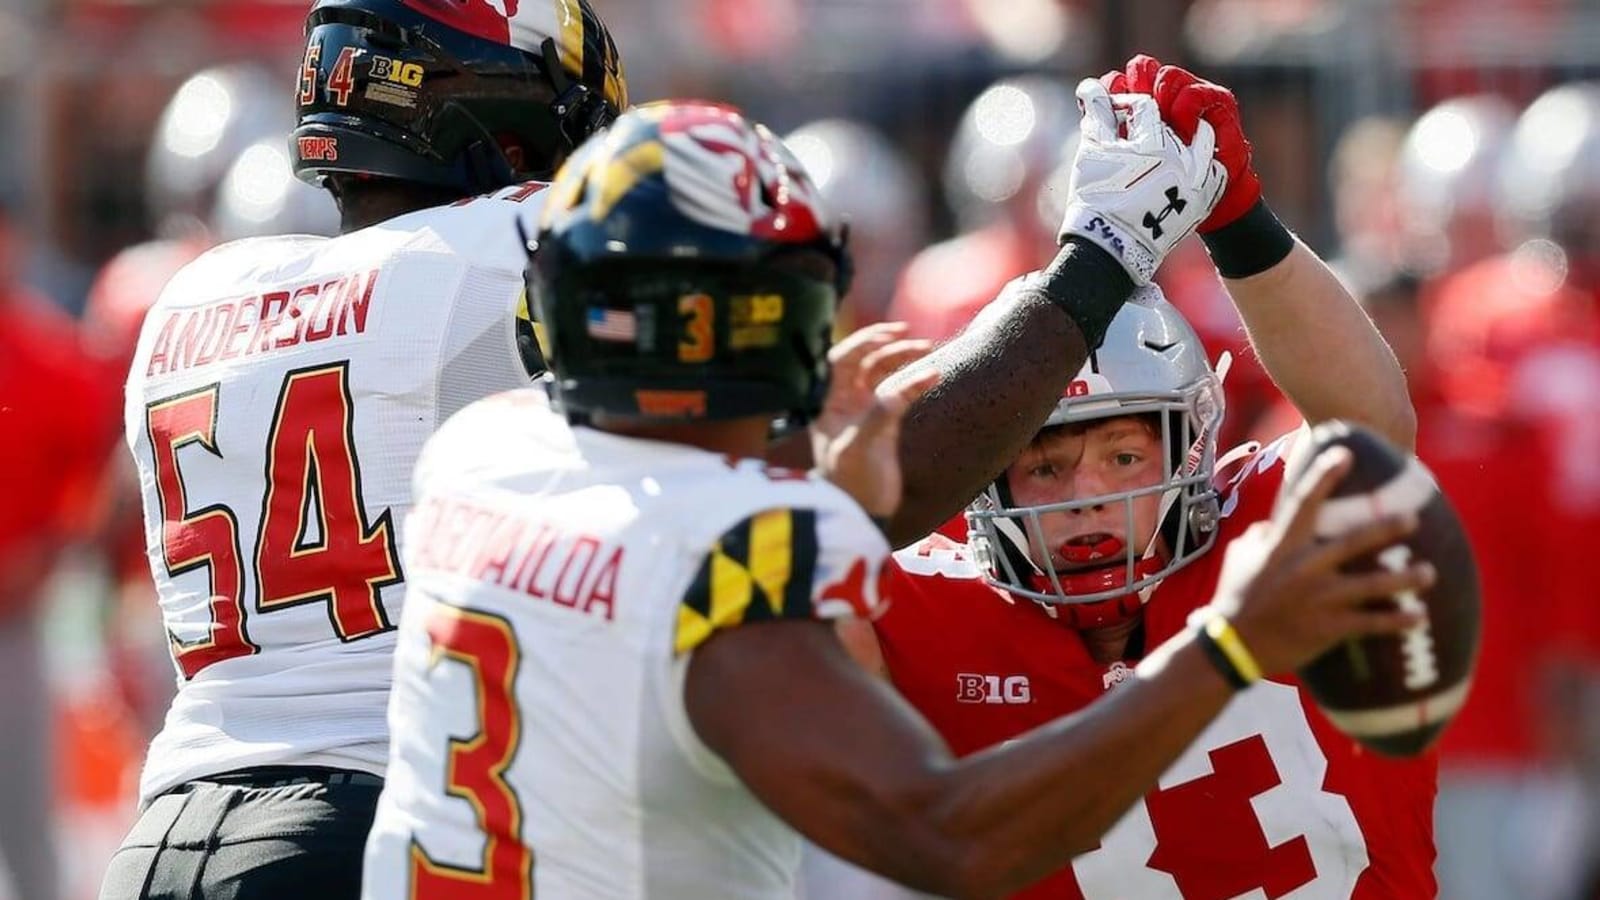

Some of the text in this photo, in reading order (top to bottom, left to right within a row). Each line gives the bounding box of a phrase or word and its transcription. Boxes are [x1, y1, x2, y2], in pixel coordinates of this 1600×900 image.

[298, 136, 338, 161] TERPS
[146, 270, 379, 377] ANDERSON
[677, 294, 715, 362] 3
[146, 360, 405, 682] 54
[408, 600, 535, 900] 3
